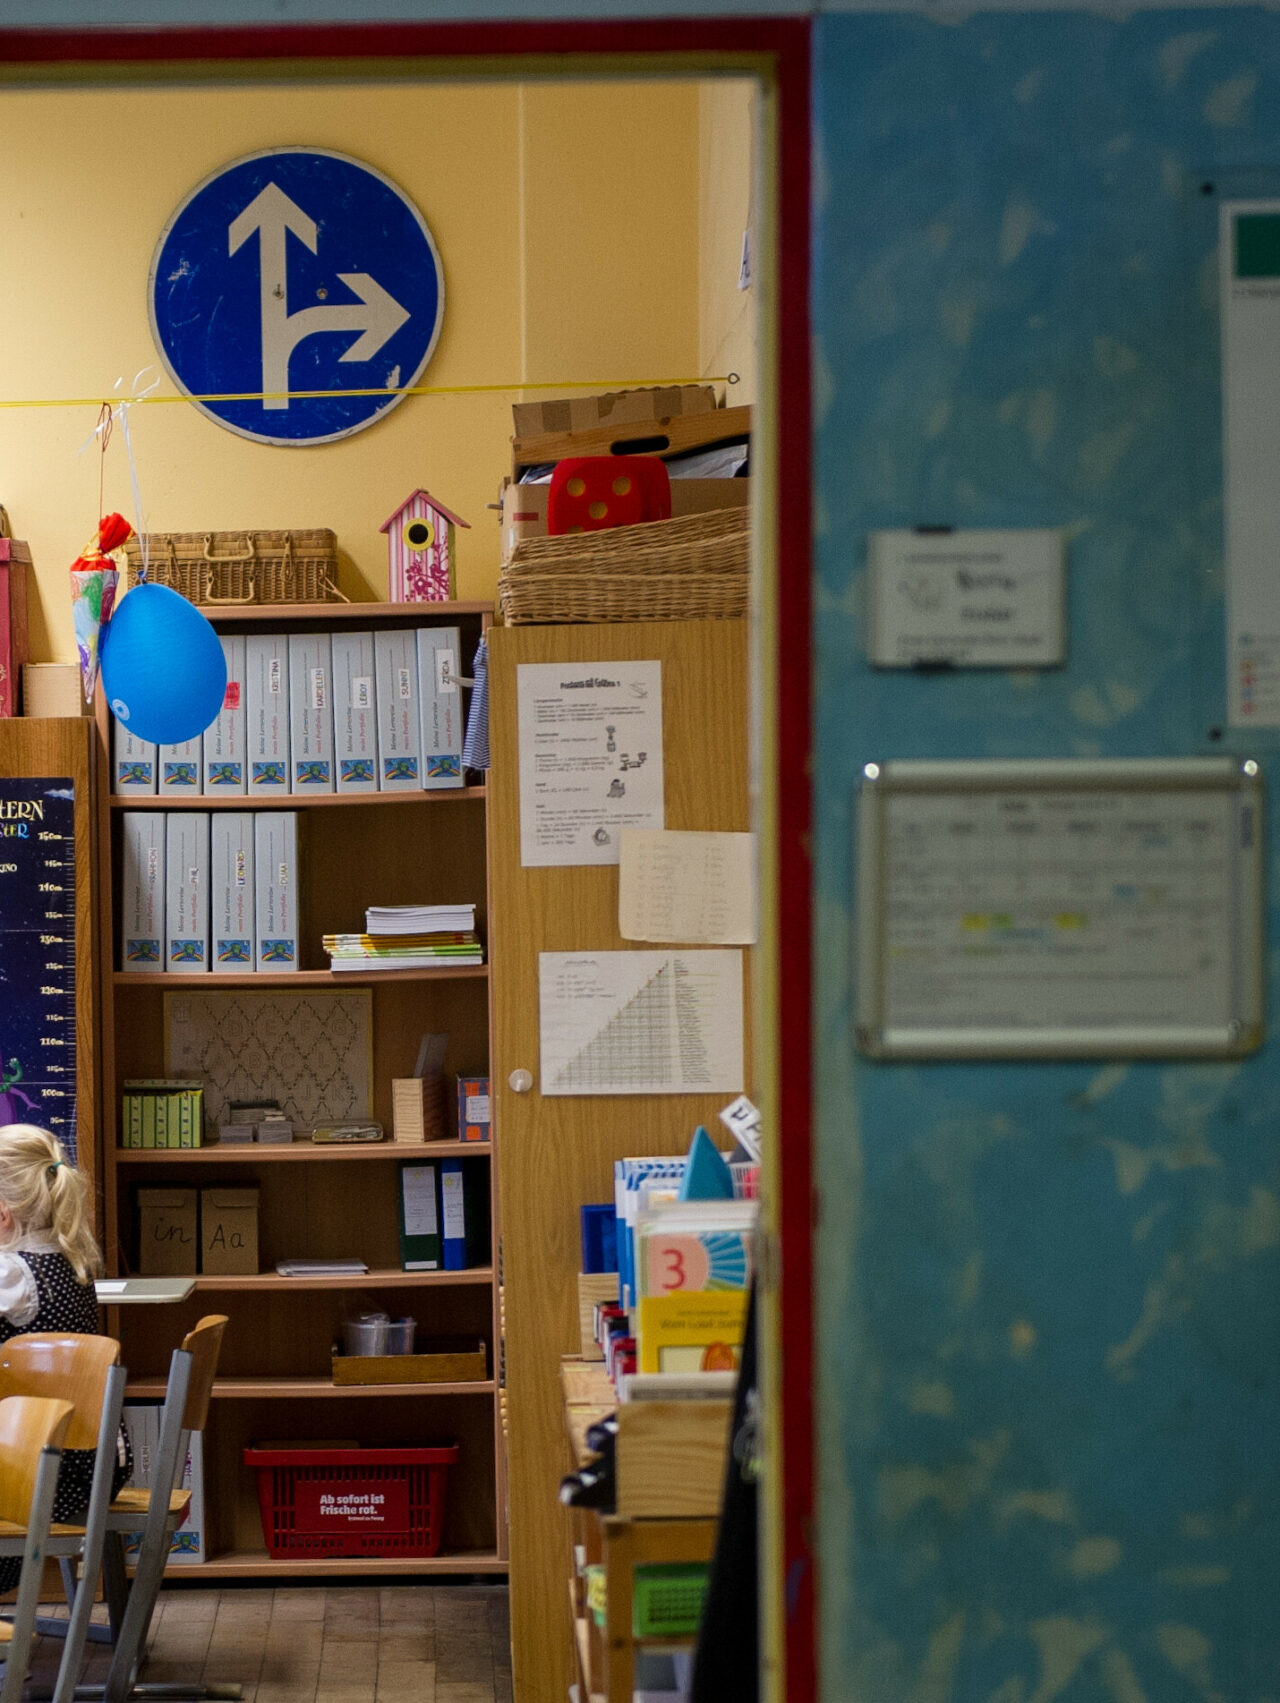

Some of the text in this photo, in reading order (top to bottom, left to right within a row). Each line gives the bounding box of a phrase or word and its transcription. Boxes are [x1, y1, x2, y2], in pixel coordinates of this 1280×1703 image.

[315, 670, 323, 707] KARDELEN
[360, 684, 368, 706] LEROY
[401, 670, 409, 696] SUNNY
[153, 1217, 193, 1244] in
[209, 1224, 245, 1250] Aa
[661, 1248, 686, 1290] 3
[320, 1493, 385, 1504] Ab sofort ist
[320, 1505, 378, 1515] Frische rot.
